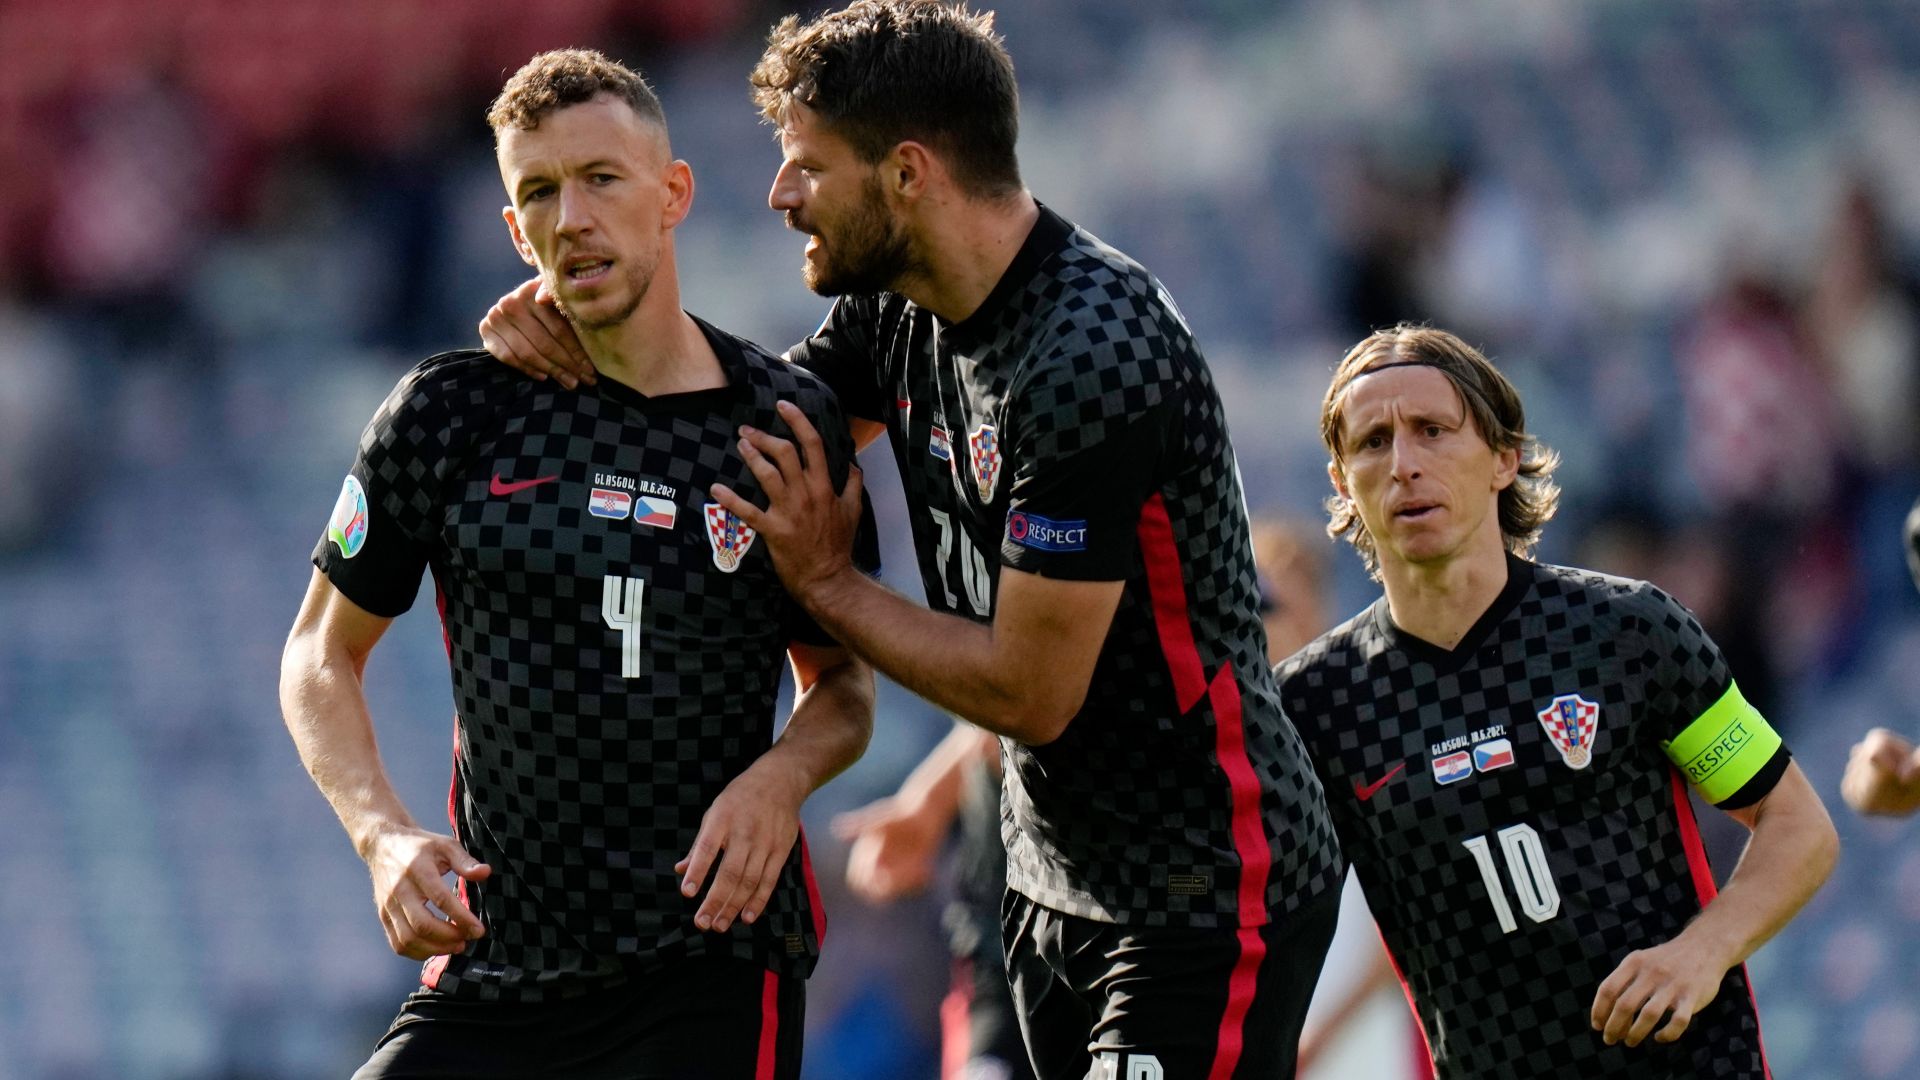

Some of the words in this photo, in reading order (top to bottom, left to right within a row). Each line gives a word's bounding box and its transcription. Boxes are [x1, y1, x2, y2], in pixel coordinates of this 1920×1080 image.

[595, 472, 636, 491] GLASGOW,
[928, 505, 990, 616] 20
[1028, 525, 1087, 544] RESPECT
[601, 574, 645, 678] 4
[1688, 722, 1748, 779] RESPECT
[1461, 822, 1561, 934] 10
